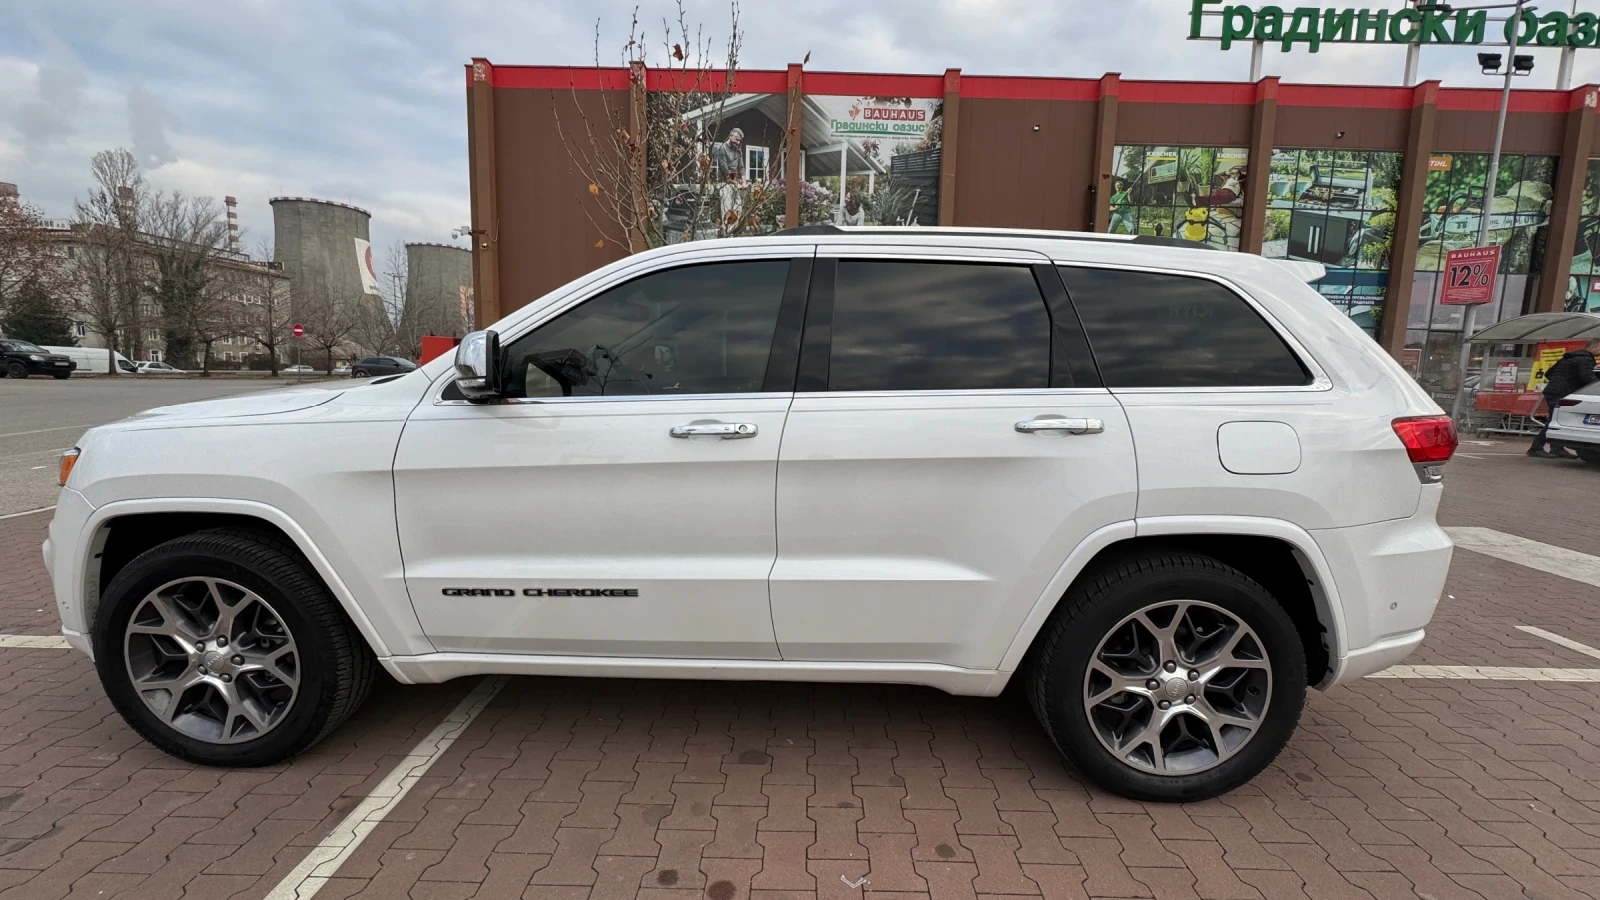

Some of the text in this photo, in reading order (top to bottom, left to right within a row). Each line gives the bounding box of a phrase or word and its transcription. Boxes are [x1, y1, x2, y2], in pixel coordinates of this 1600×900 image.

[1190, 0, 1600, 53] Градински оаз
[864, 108, 925, 121] BAUHAUS
[831, 119, 925, 132] Градински оазис
[1451, 249, 1497, 259] BAUHAUS
[1450, 263, 1489, 287] 12%
[442, 588, 639, 597] GRAND CHEROKEE
